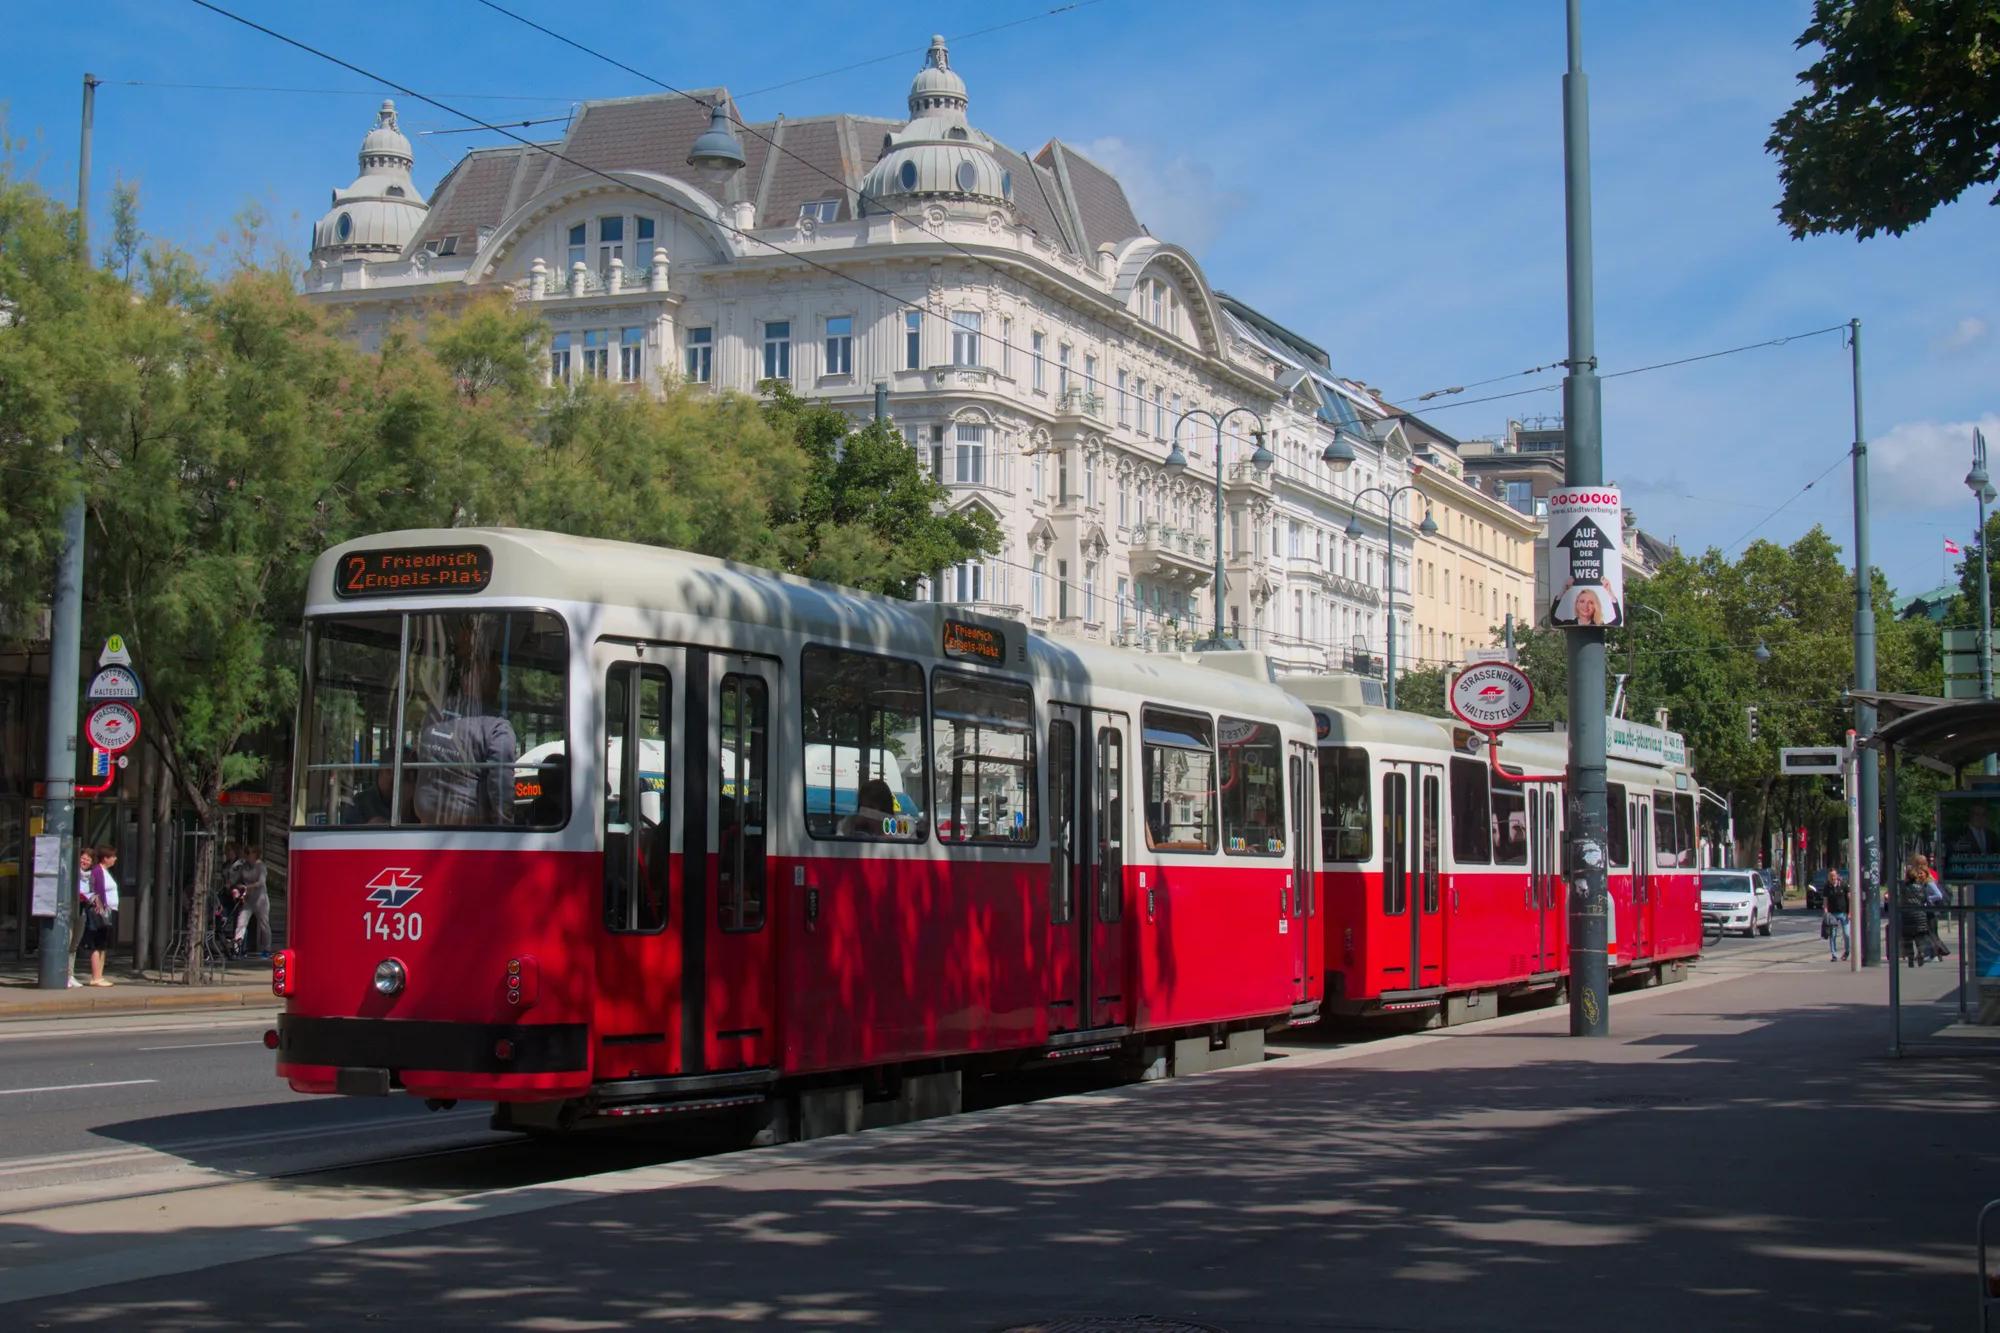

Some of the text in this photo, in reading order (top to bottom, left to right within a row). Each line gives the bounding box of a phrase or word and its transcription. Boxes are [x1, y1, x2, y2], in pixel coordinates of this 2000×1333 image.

[1575, 528, 1597, 538] AUF
[1573, 540, 1599, 548] DAUER
[381, 552, 478, 569] Friedrich
[347, 557, 366, 590] 2
[1575, 569, 1599, 579] WEG
[111, 639, 120, 649] H
[101, 669, 130, 682] AUTOBUS
[1460, 669, 1524, 692] STRASSENBAHN
[93, 706, 134, 724] STRASSENBAHN
[1462, 701, 1521, 720] HALTESTELLE
[94, 732, 131, 746] HALTESTELLE
[363, 911, 422, 941] 1430
